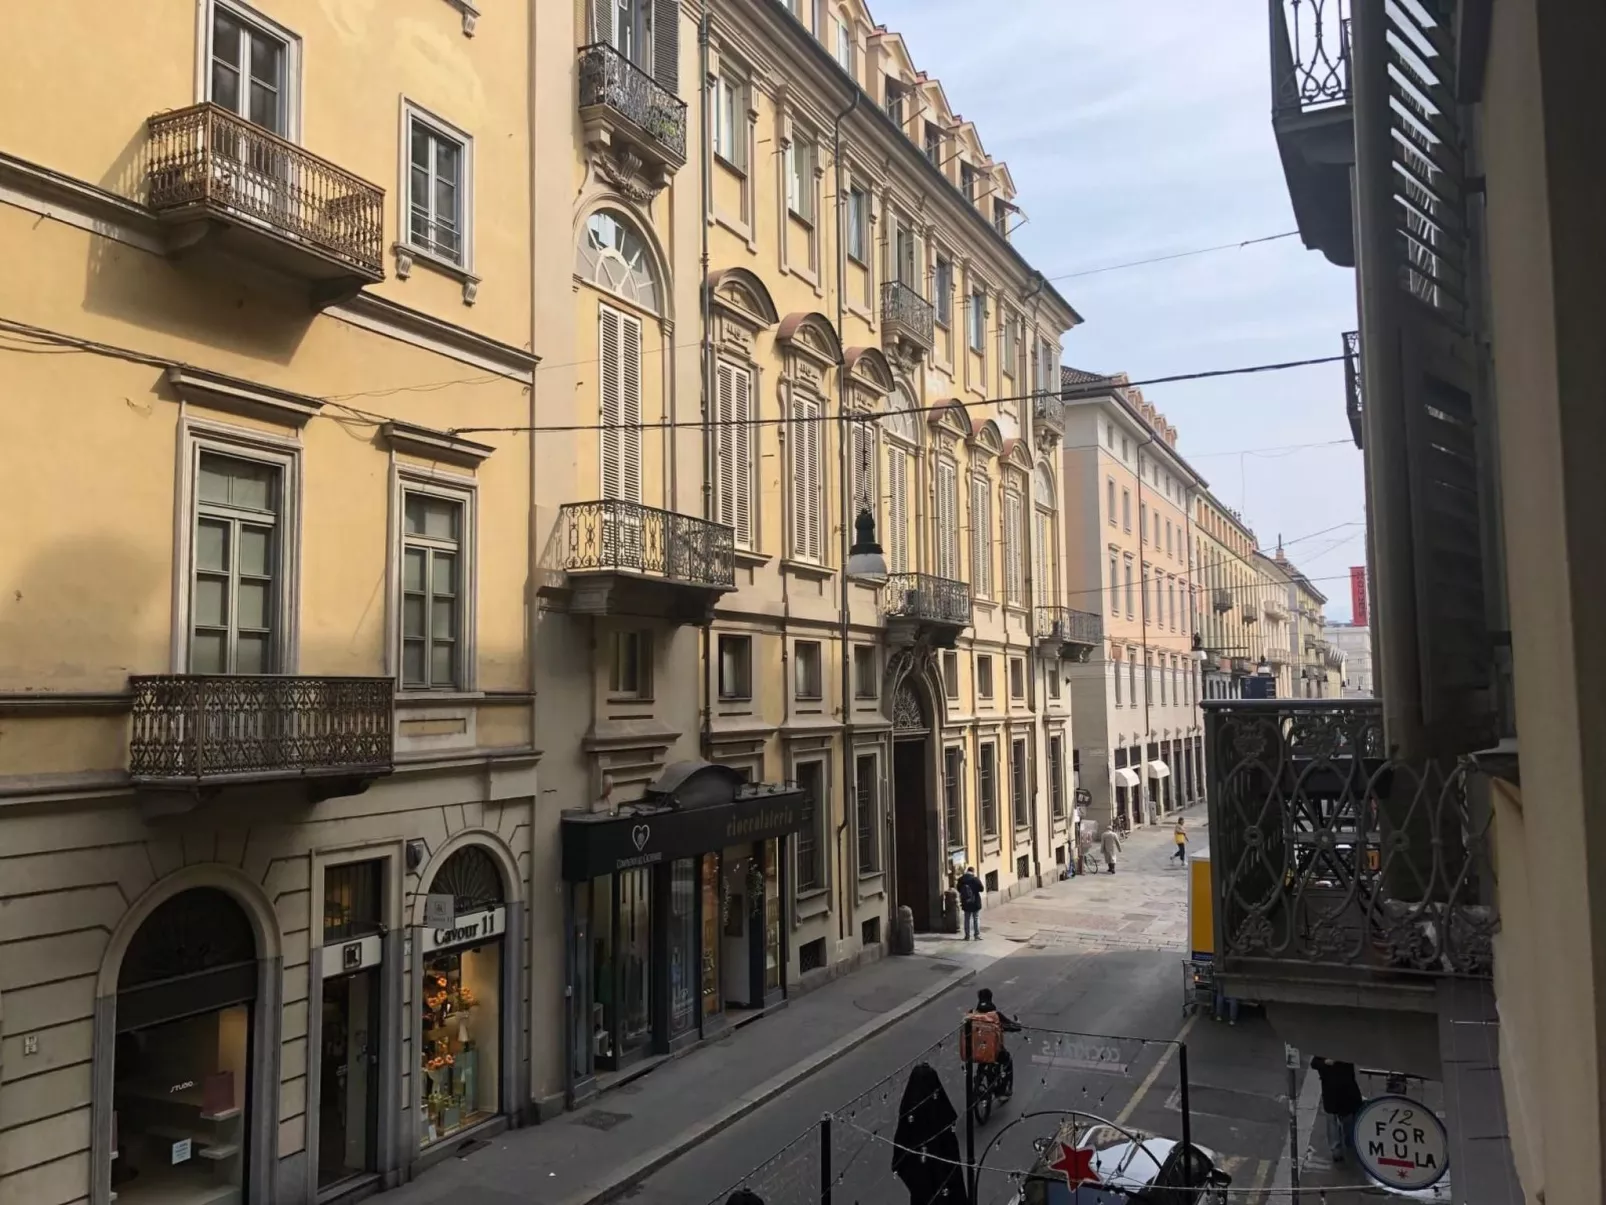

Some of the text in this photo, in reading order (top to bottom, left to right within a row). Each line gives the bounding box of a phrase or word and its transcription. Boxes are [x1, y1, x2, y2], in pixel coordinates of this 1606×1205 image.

[434, 912, 495, 945] Cavour 11
[170, 1081, 194, 1093] STUDIO
[1385, 1108, 1414, 1126] 12
[1375, 1121, 1426, 1144] FOR
[1368, 1141, 1437, 1169] MULA
